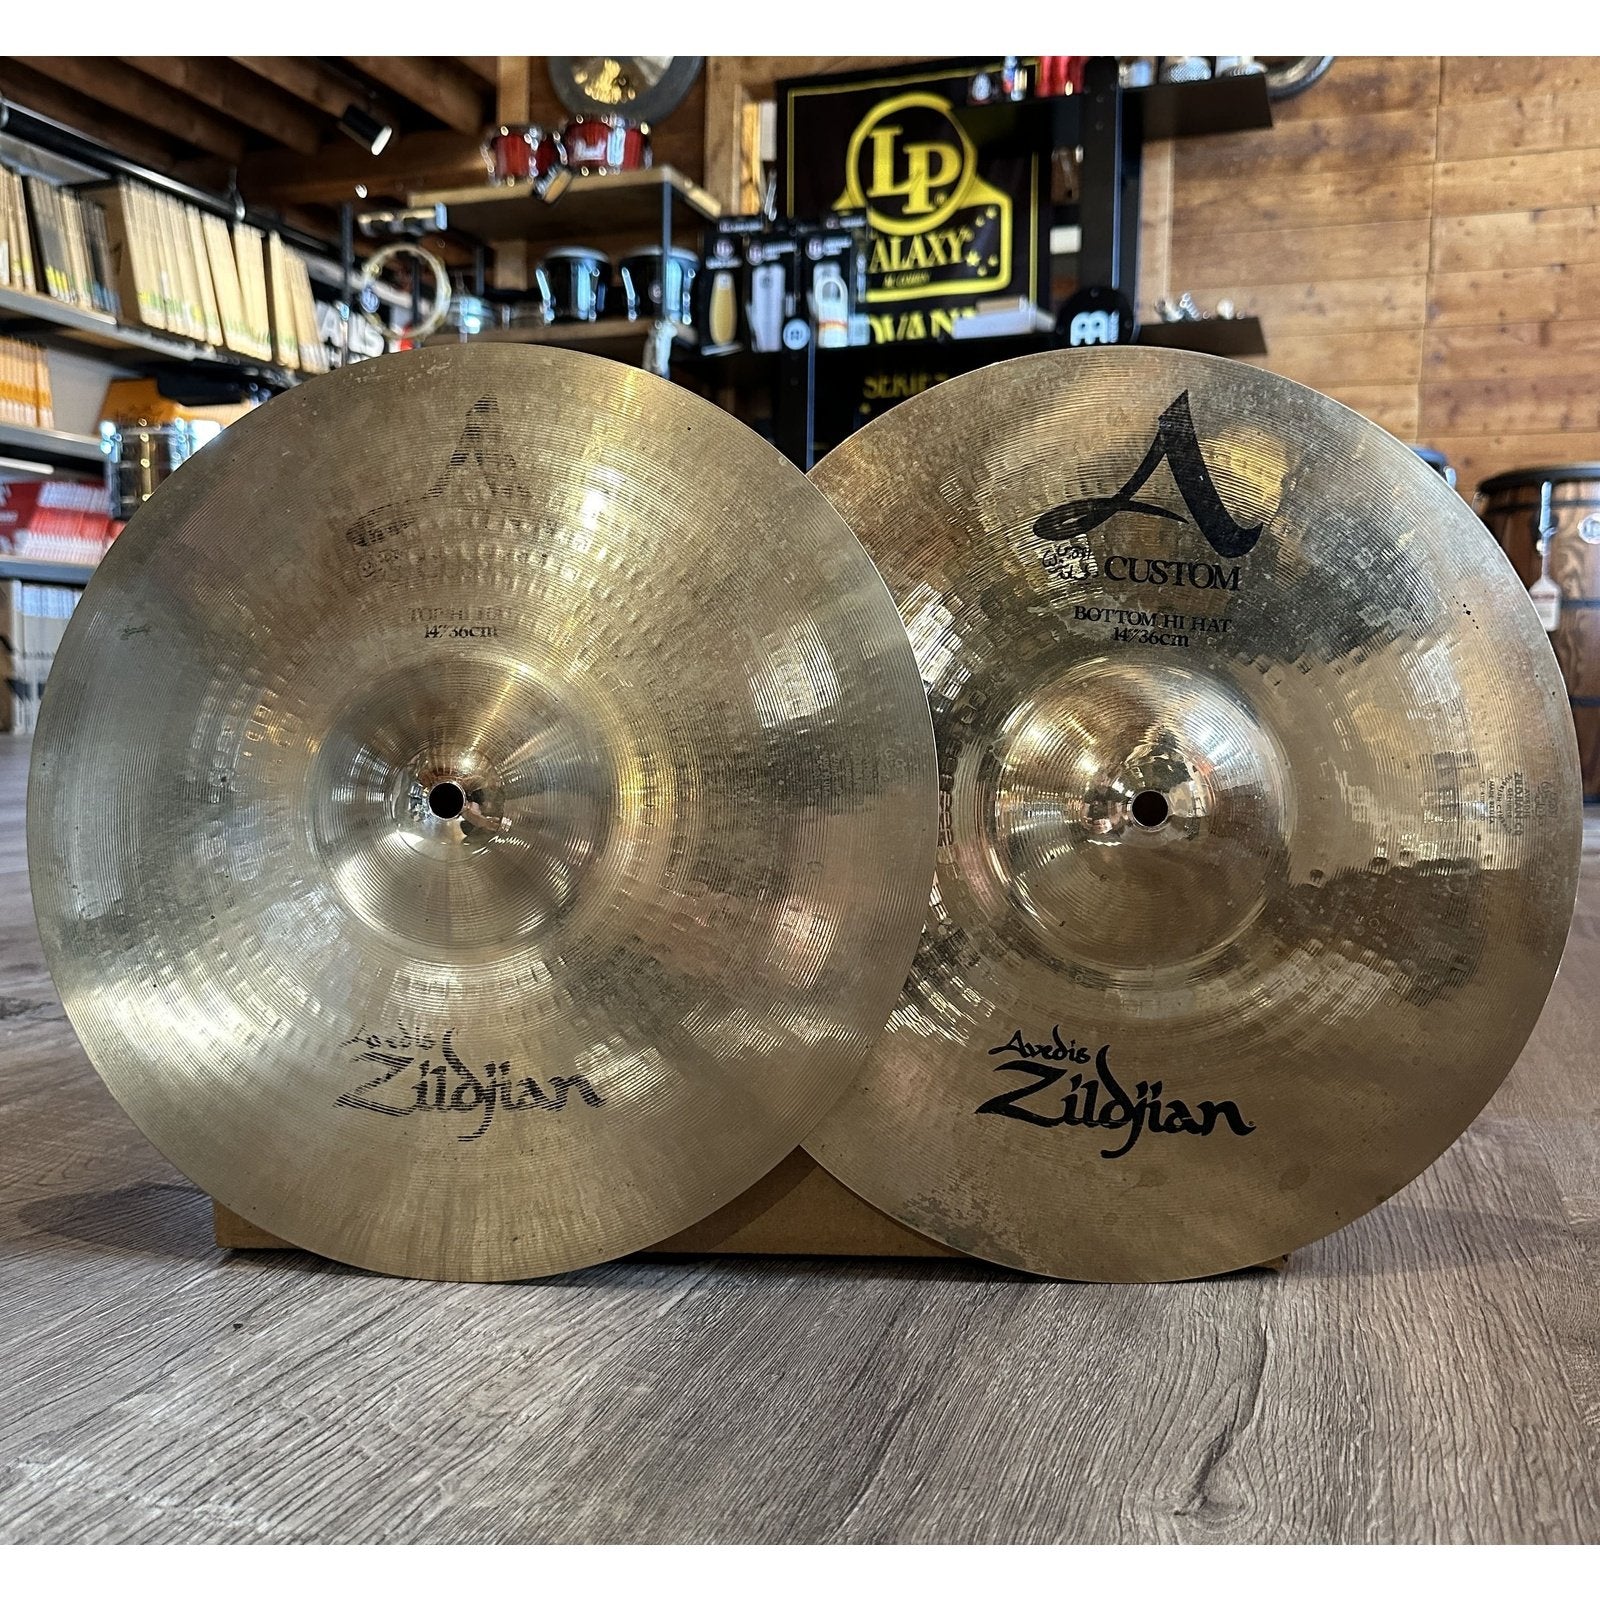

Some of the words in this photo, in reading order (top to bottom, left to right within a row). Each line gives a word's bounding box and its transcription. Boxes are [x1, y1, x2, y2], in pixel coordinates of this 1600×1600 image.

[866, 126, 963, 215] LP
[868, 228, 965, 275] ALAXY
[1033, 389, 1264, 558] A
[1104, 555, 1242, 592] CUSTOM
[1073, 605, 1157, 627] BOTTOM
[1163, 614, 1186, 631] HI
[1191, 616, 1233, 634] HAT
[1112, 626, 1190, 648] 14"/36cm
[988, 1024, 1091, 1064] Avedis
[332, 1027, 607, 1142] Zildjian
[974, 1045, 1257, 1160] Zildjian
